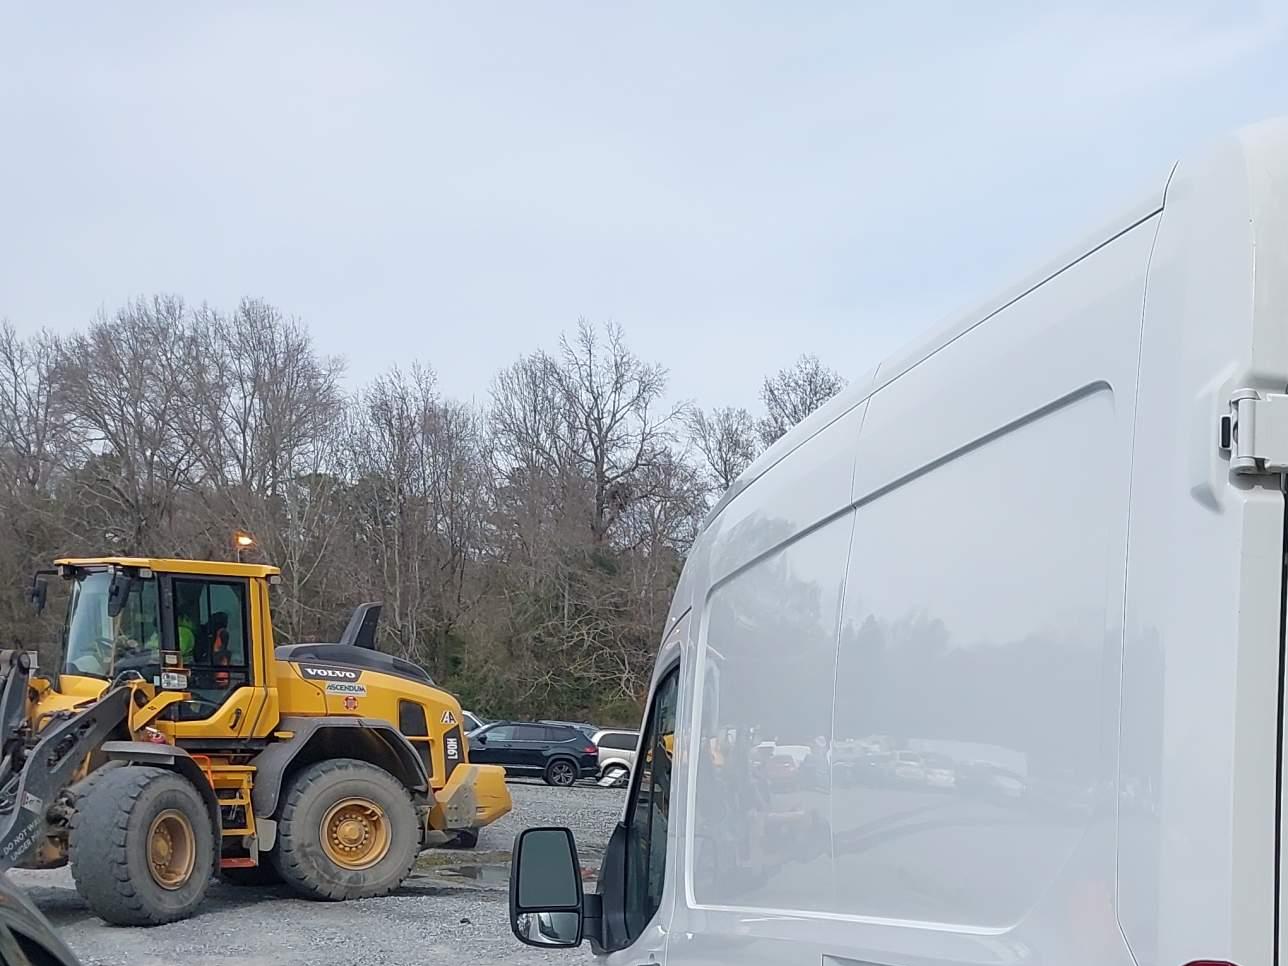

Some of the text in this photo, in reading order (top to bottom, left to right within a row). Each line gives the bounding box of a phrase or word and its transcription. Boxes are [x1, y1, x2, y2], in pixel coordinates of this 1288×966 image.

[304, 668, 356, 678] VOLVO
[3, 842, 14, 855] DO
[14, 829, 28, 845] NOT
